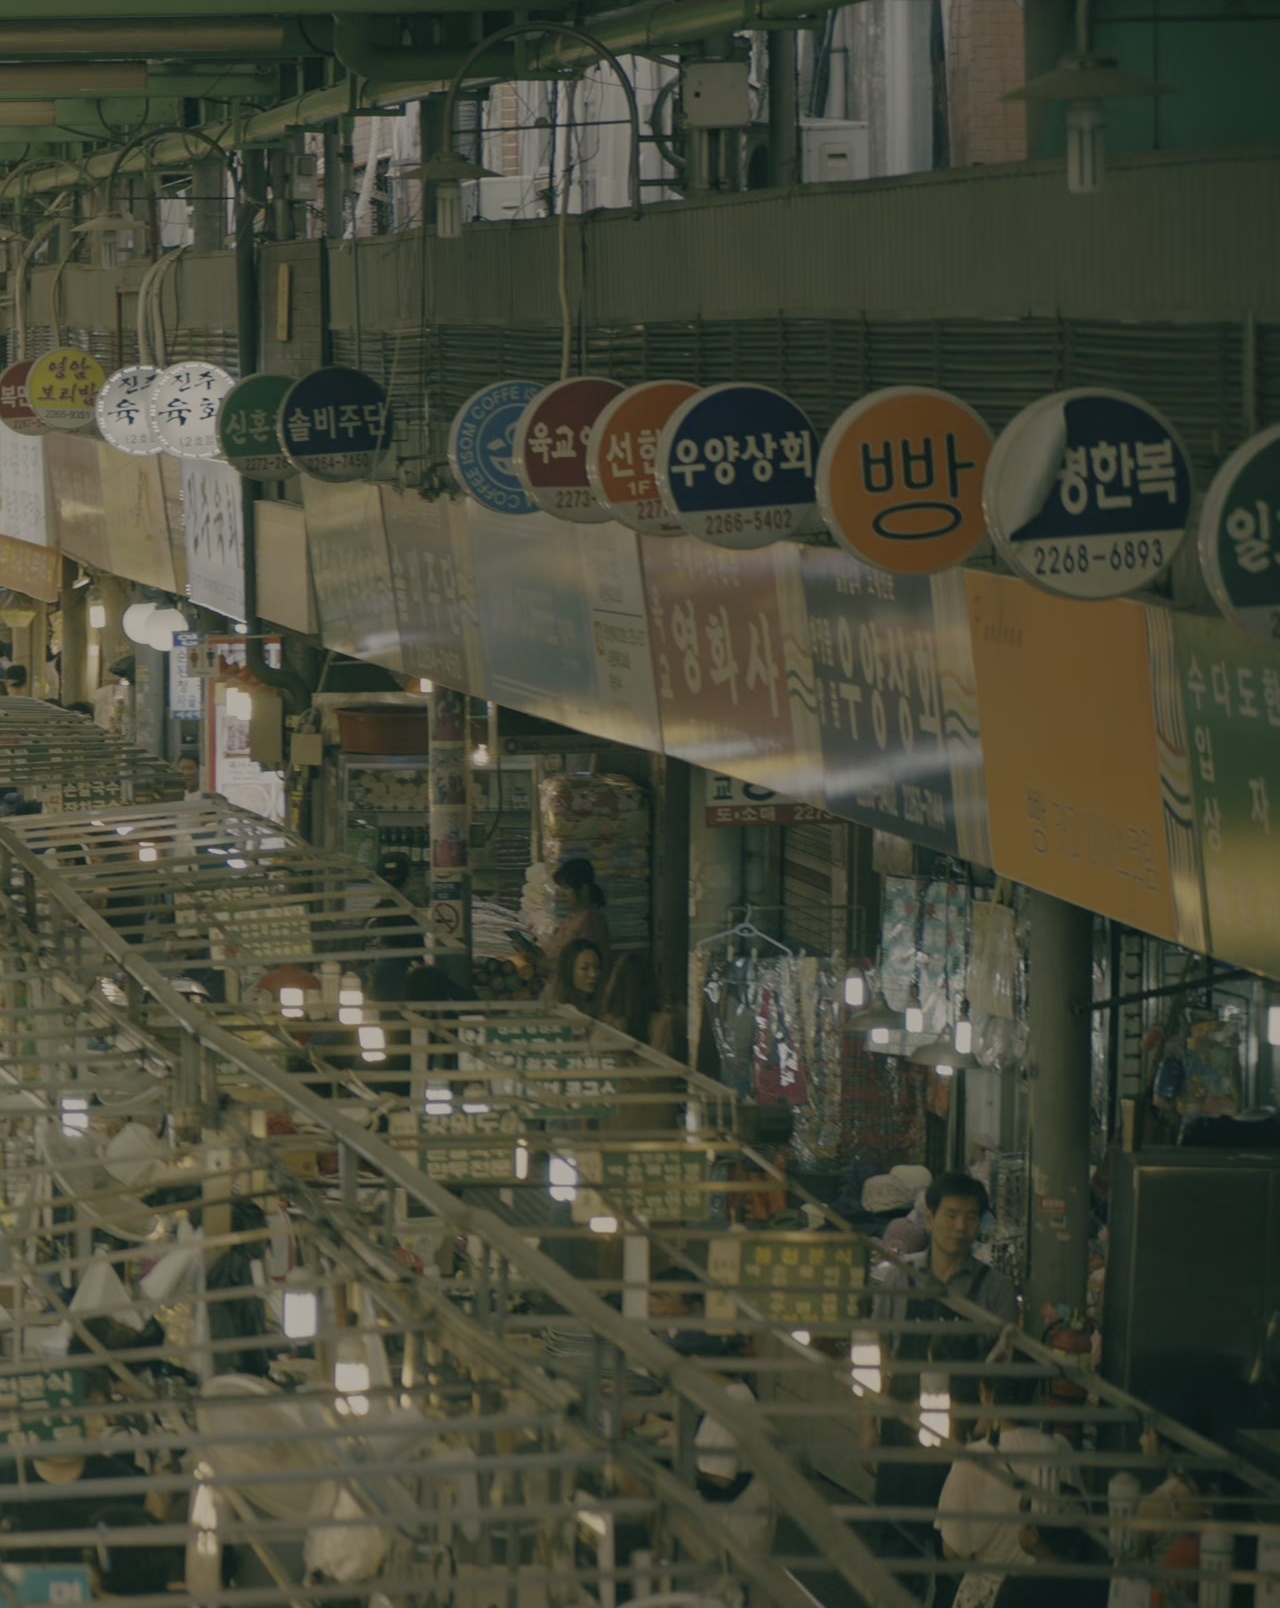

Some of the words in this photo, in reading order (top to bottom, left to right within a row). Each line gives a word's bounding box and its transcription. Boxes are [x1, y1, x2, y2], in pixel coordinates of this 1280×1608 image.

[48, 357, 92, 380] 영암
[171, 371, 216, 392] 진주
[107, 398, 140, 425] 육
[225, 408, 281, 445] 신혼
[288, 402, 386, 442] 솔비주단
[458, 424, 478, 467] ISOM
[670, 429, 814, 487] 우양상회
[861, 432, 975, 541] 빵
[705, 508, 792, 537] 2266-5402
[1225, 500, 1280, 573] 일
[1033, 538, 1164, 576] 2268-6893
[670, 598, 781, 720] 영화사
[838, 614, 946, 754] 우양상회
[63, 781, 120, 798] 손칼국수
